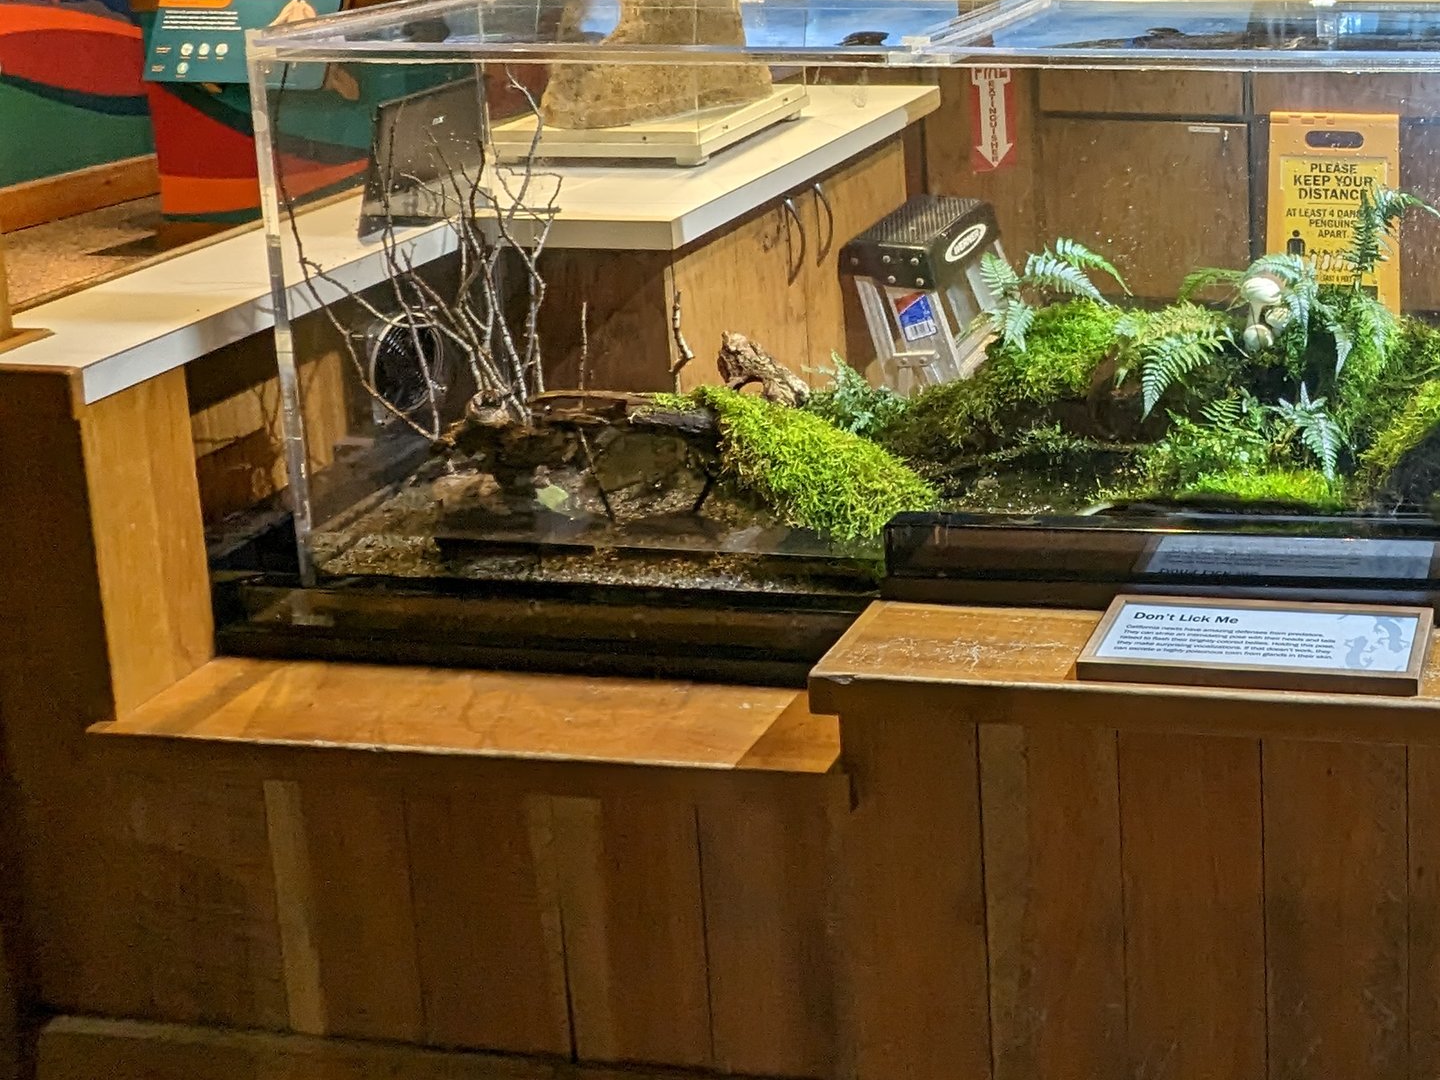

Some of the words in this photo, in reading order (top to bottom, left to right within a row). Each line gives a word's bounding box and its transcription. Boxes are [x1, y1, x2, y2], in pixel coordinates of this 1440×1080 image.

[1310, 163, 1358, 174] PLEASE
[1294, 175, 1331, 186] KEEP
[1334, 176, 1373, 187] YOUR
[1286, 208, 1296, 217] AT
[1299, 208, 1327, 217] LEAST
[1329, 209, 1334, 217] 4
[1134, 612, 1175, 621] Don't
[1178, 614, 1210, 622] Lick
[1214, 616, 1238, 624] Me
